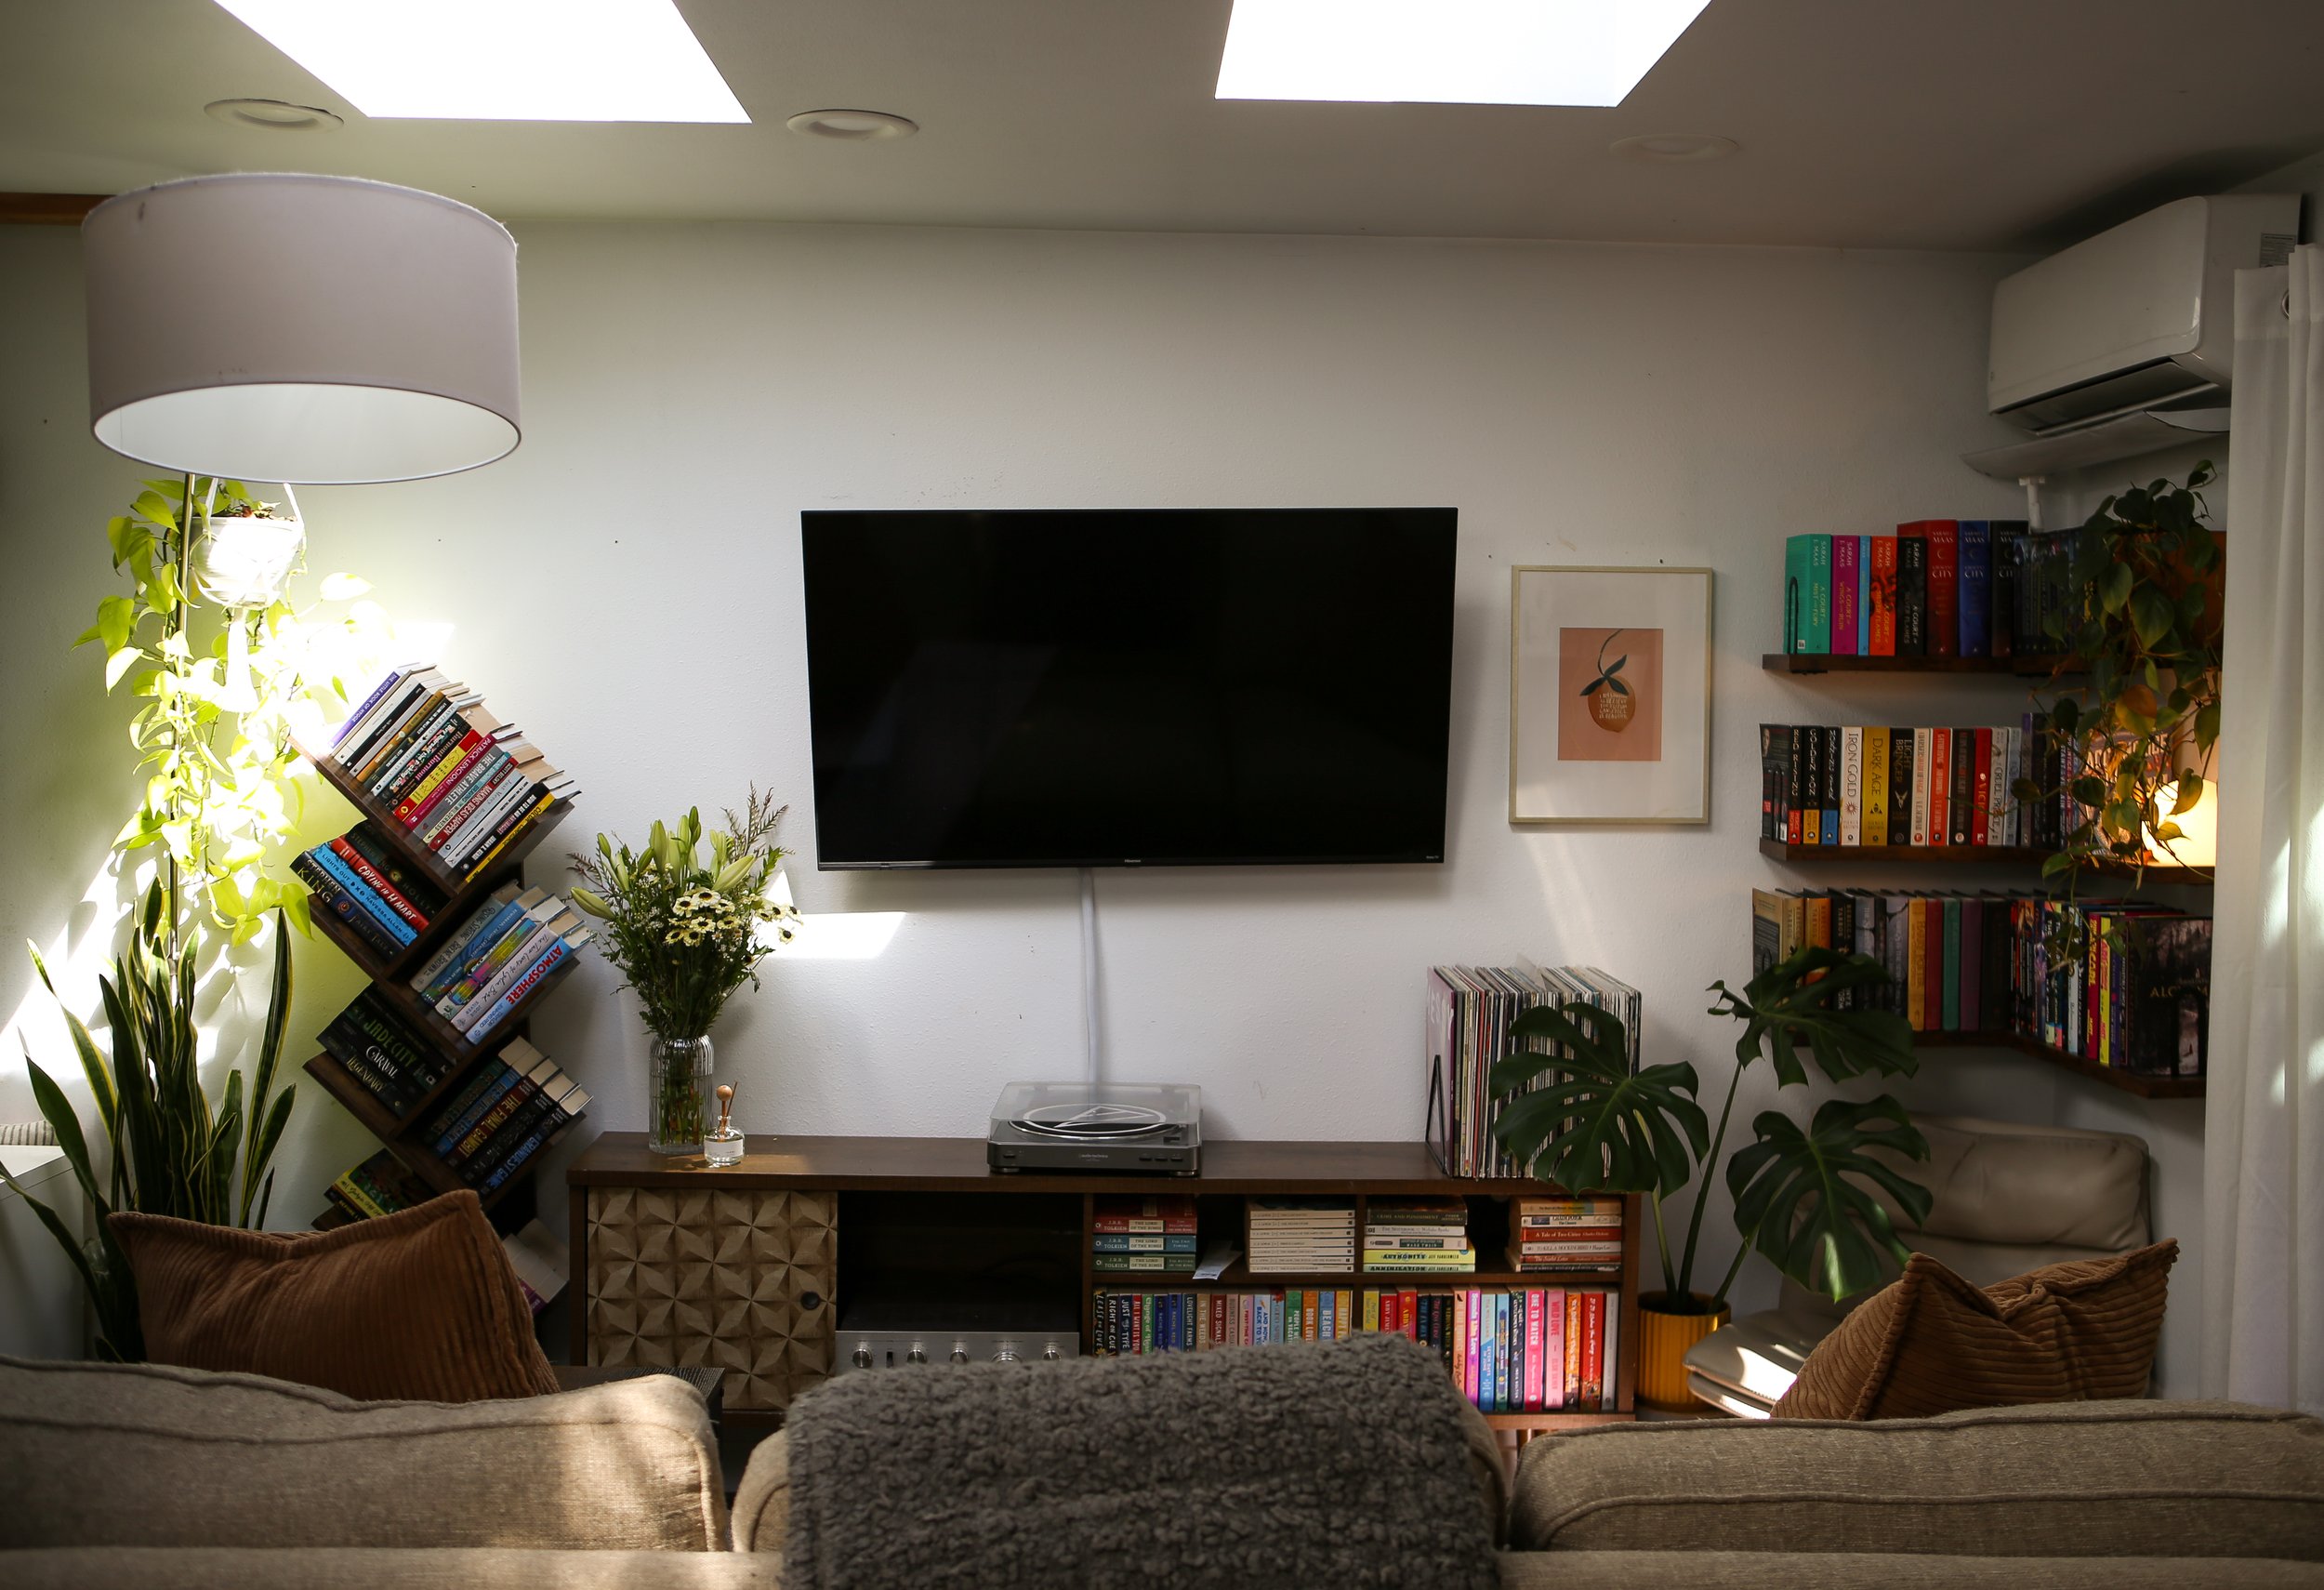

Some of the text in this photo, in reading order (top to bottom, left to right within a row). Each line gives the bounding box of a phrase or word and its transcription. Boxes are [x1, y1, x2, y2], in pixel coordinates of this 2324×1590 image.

[1932, 571, 1952, 579] CITY
[1964, 571, 1985, 579] CITY
[378, 680, 390, 693] LITTLE
[388, 673, 397, 682] THE
[367, 691, 380, 704] BOOK
[350, 708, 364, 722] HYGGE
[415, 730, 463, 781] Burnout Burnout
[416, 722, 453, 761] Buy Yourself the
[444, 736, 491, 785] PATRICK LENCIONI
[1845, 733, 1858, 797] IRON GOLD
[1870, 737, 1882, 796] DARK AGE
[443, 751, 495, 805] THE BRAVE ATHLETE
[486, 778, 512, 805] Just Mercy
[491, 771, 504, 785] BELSKY
[434, 804, 459, 831] WILDERNESS
[442, 783, 493, 836] MAKING IDEAS HAPPEN
[512, 792, 536, 818] HOW TO BE AN
[305, 858, 340, 894] STEPHEN
[321, 853, 350, 881] LIGHTS OUT
[296, 865, 335, 904] KING
[356, 863, 384, 891] CRYING
[386, 892, 397, 903] H
[392, 898, 416, 922] MART
[402, 881, 431, 910] HOLLY
[365, 895, 403, 933] NAVESSA ALLEN
[458, 904, 495, 941] RISING STRONG
[427, 954, 447, 974] BROWN
[480, 933, 550, 1003] The Two Lives of Lydia Bird
[504, 944, 564, 1006] ATMOSPHERE
[465, 1000, 479, 1014] SILVER
[469, 1004, 482, 1017] JOSIE
[486, 1010, 503, 1027] TAYLOR
[362, 1015, 417, 1069] JADE CITY
[344, 1053, 387, 1095] LEGENDARY
[362, 1041, 403, 1081] CARAVAL
[499, 1092, 522, 1114] THE
[480, 1106, 508, 1134] FINAL
[456, 1126, 489, 1159] GAMBIT
[484, 1134, 540, 1190] GRANDEST GAME
[1096, 1295, 1104, 1347] LEASE LOVE
[1121, 1300, 1129, 1317] JUST
[1323, 1310, 1331, 1336] BEACH
[1338, 1308, 1348, 1329] HAPPY
[1530, 1294, 1539, 1345] ONE TO WATCH
[1551, 1320, 1559, 1336] LOVE
